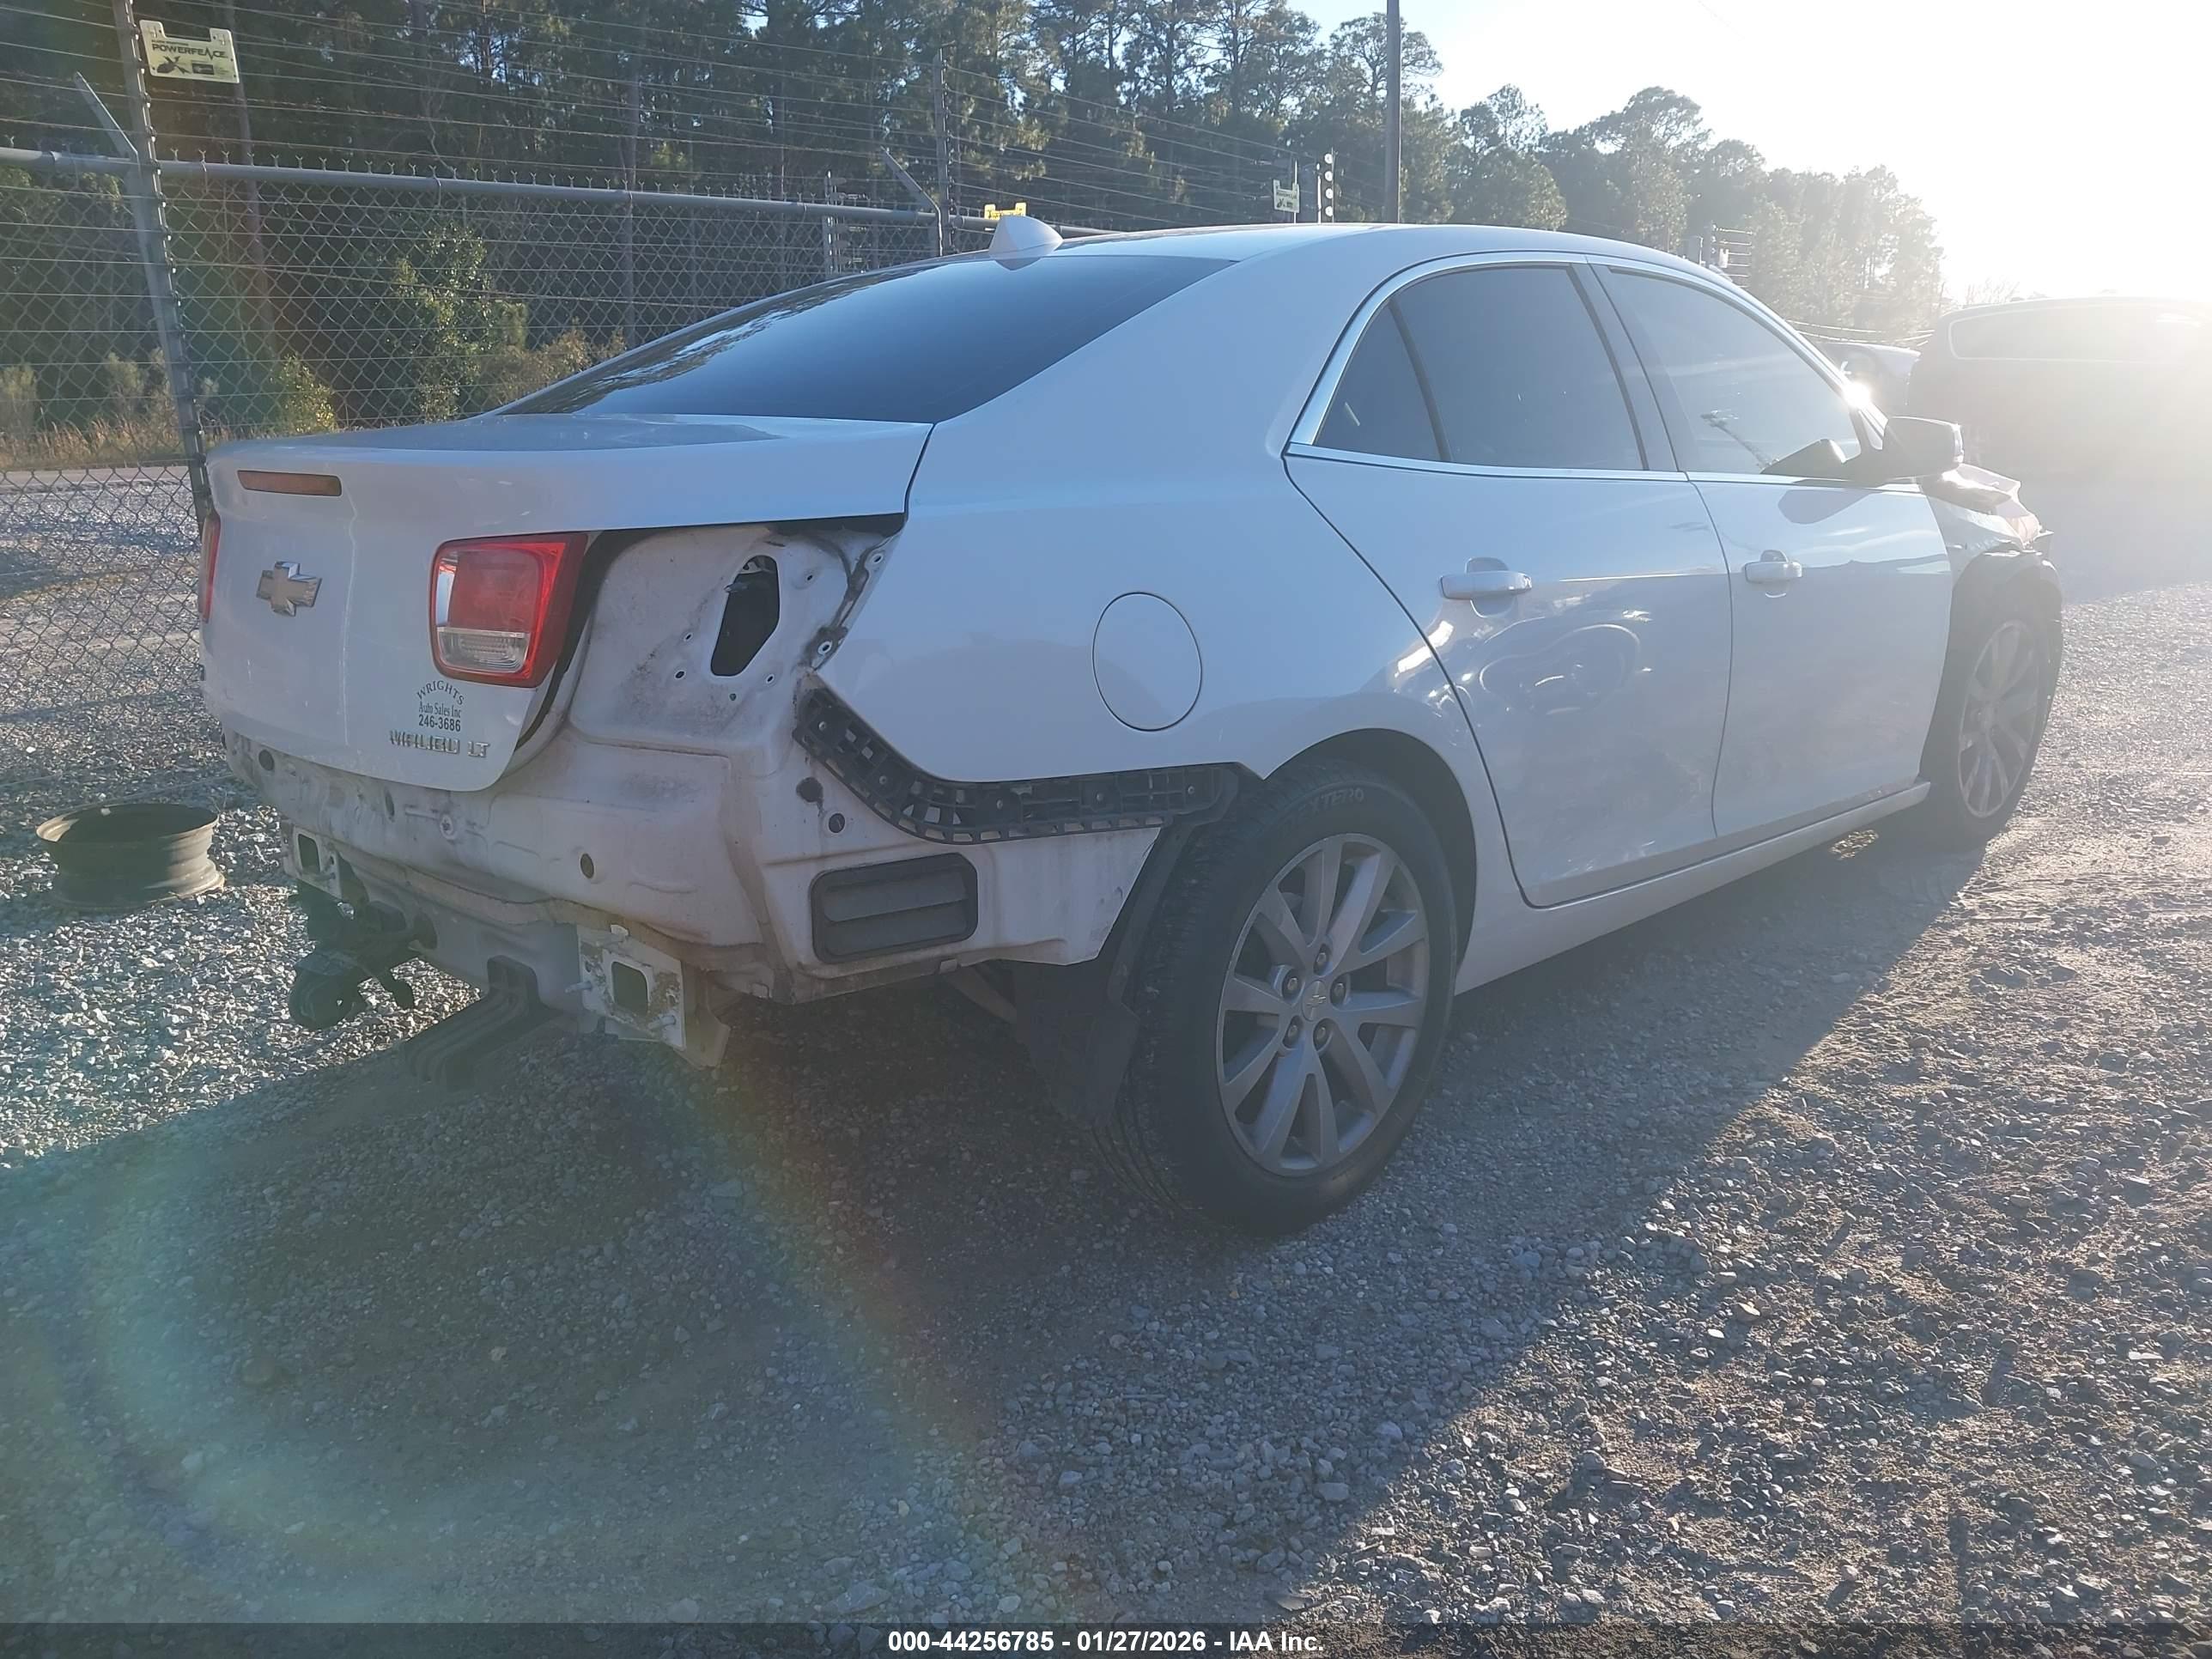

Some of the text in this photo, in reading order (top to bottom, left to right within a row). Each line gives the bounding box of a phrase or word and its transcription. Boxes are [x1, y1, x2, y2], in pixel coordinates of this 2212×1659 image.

[152, 43, 228, 60] POWERFENCE
[416, 680, 465, 705] WRIGHTS
[419, 701, 462, 718] Auto Sales Inc
[418, 714, 461, 732] 246-3686
[390, 730, 490, 757] MALIBU LT
